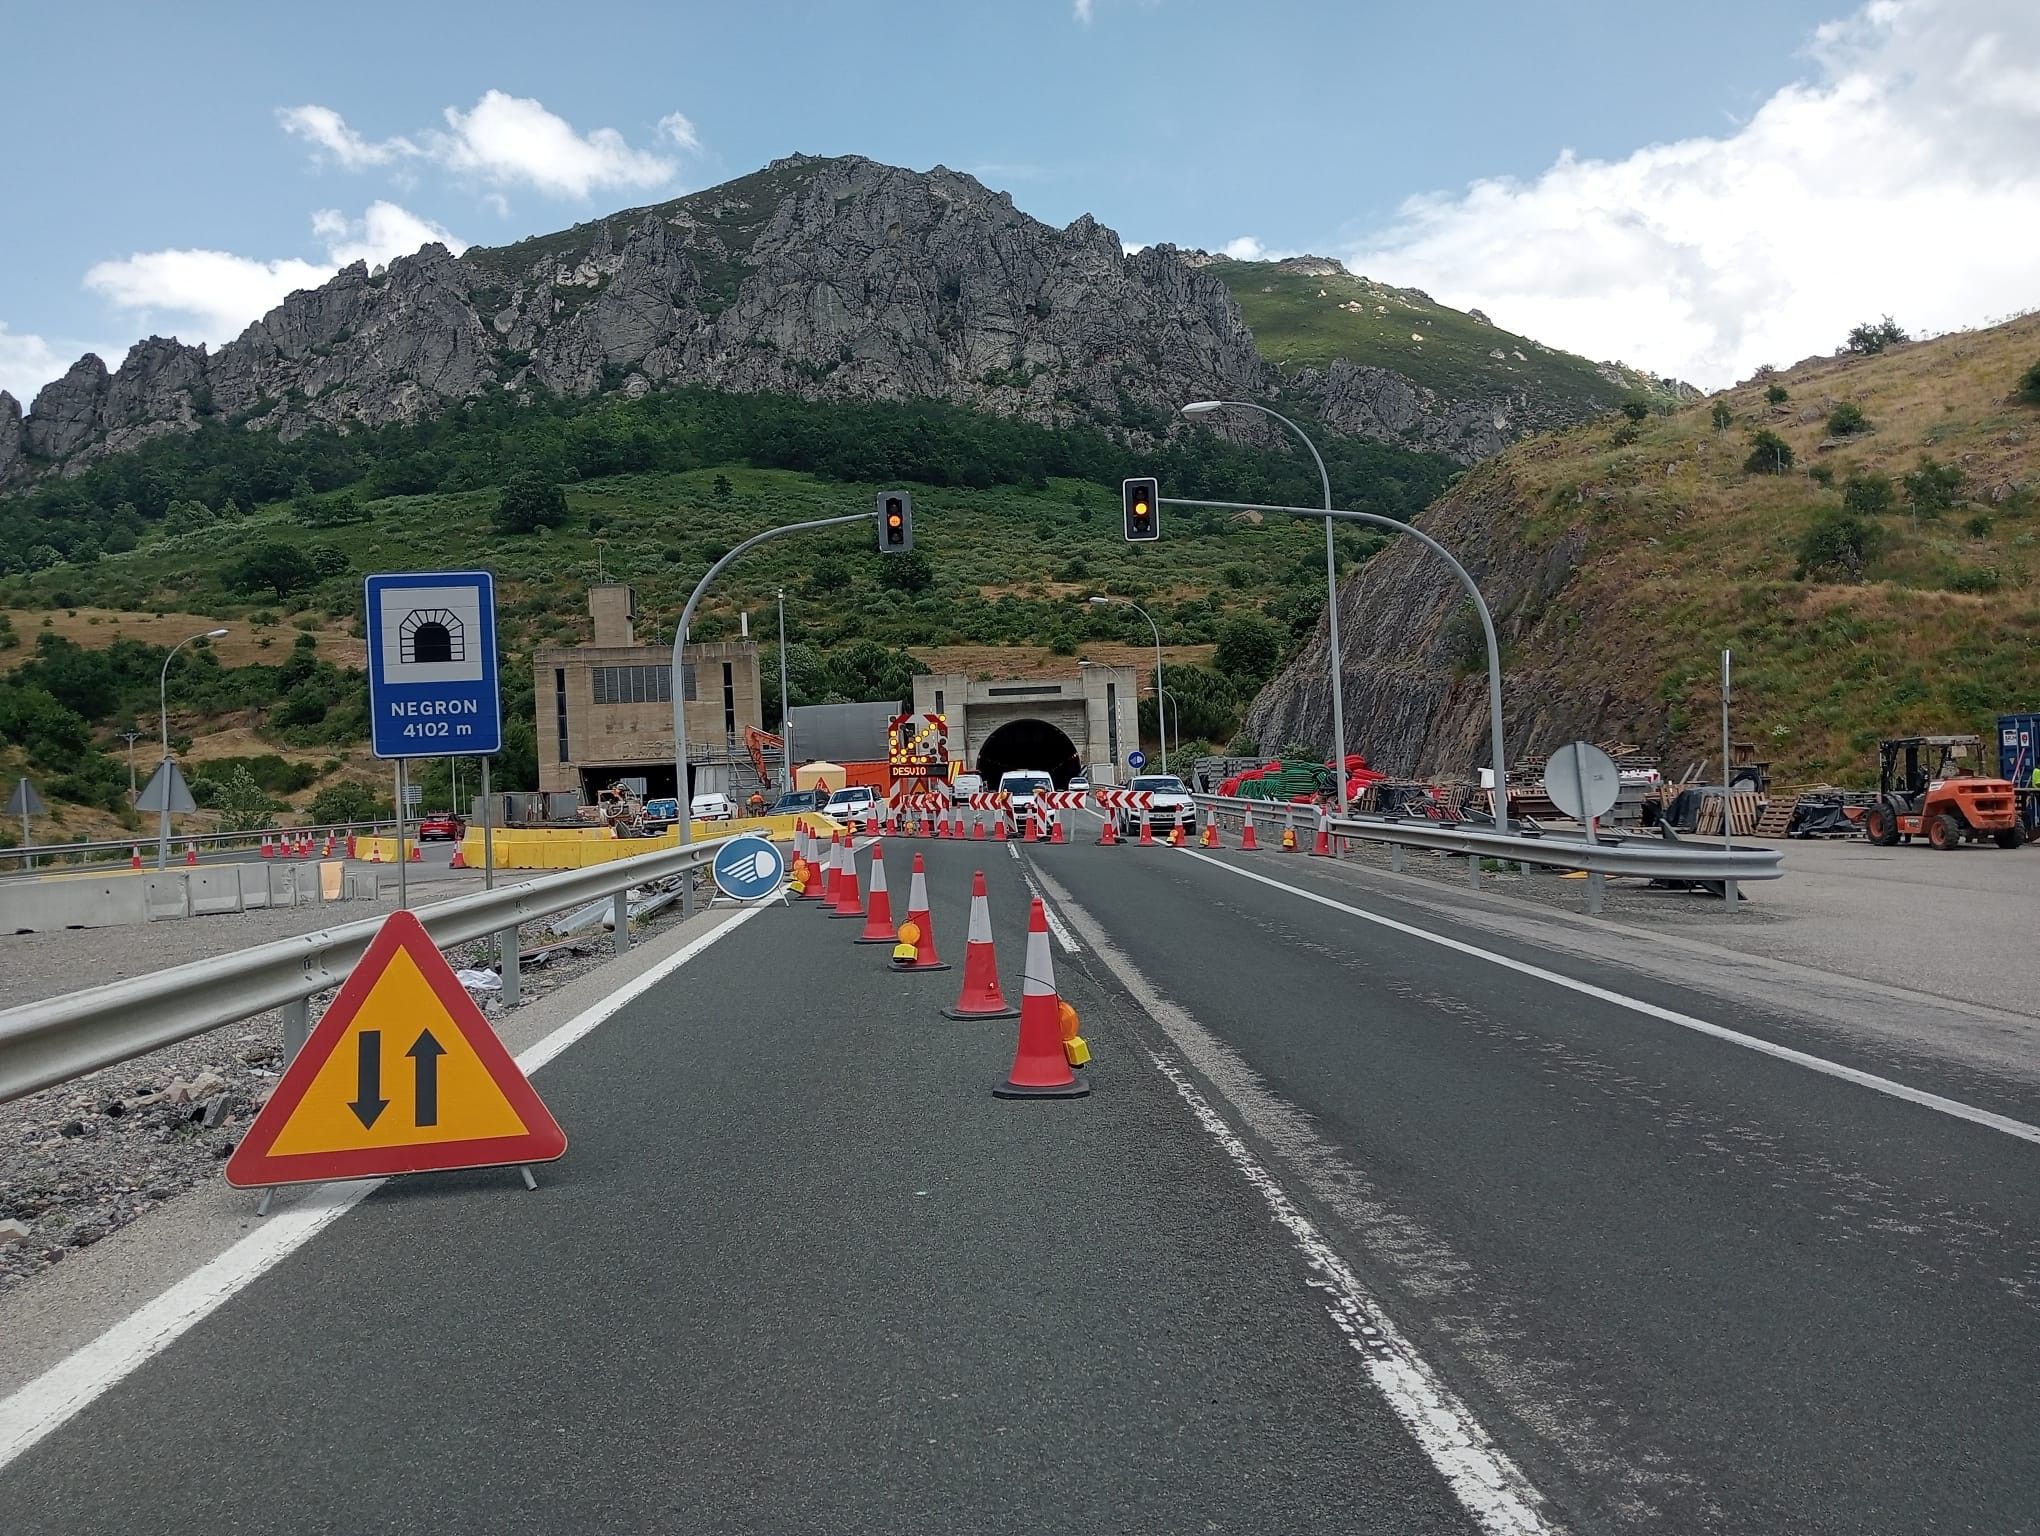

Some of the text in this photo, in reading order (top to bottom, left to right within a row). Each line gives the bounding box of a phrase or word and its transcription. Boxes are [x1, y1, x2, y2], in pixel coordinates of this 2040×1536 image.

[391, 699, 478, 716] NEGRON
[403, 722, 472, 738] 4102 m
[892, 767, 926, 775] DESVIO
